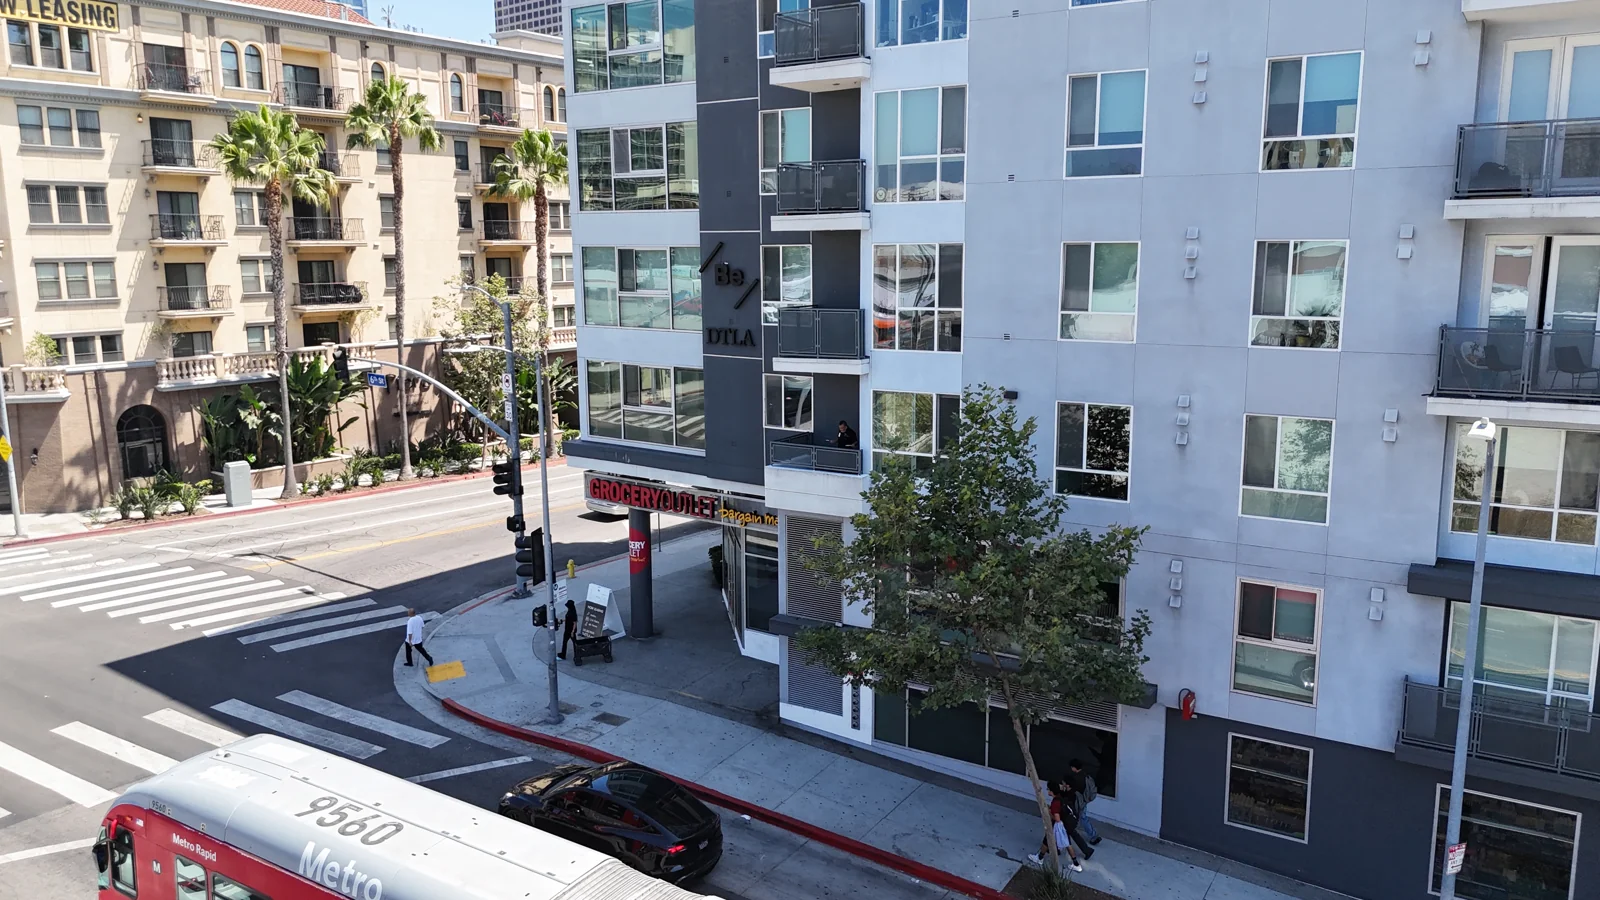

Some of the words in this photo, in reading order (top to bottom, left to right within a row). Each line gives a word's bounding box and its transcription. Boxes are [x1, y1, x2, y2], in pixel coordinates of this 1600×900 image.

[27, 0, 116, 28] LEASING
[714, 263, 745, 287] Be
[706, 327, 756, 347] DTLA
[589, 478, 661, 510] GROCERY
[151, 800, 167, 813] 9560
[294, 796, 404, 845] 9560
[172, 832, 195, 852] Metro
[196, 843, 217, 862] Rapid
[298, 840, 383, 900] Metro
